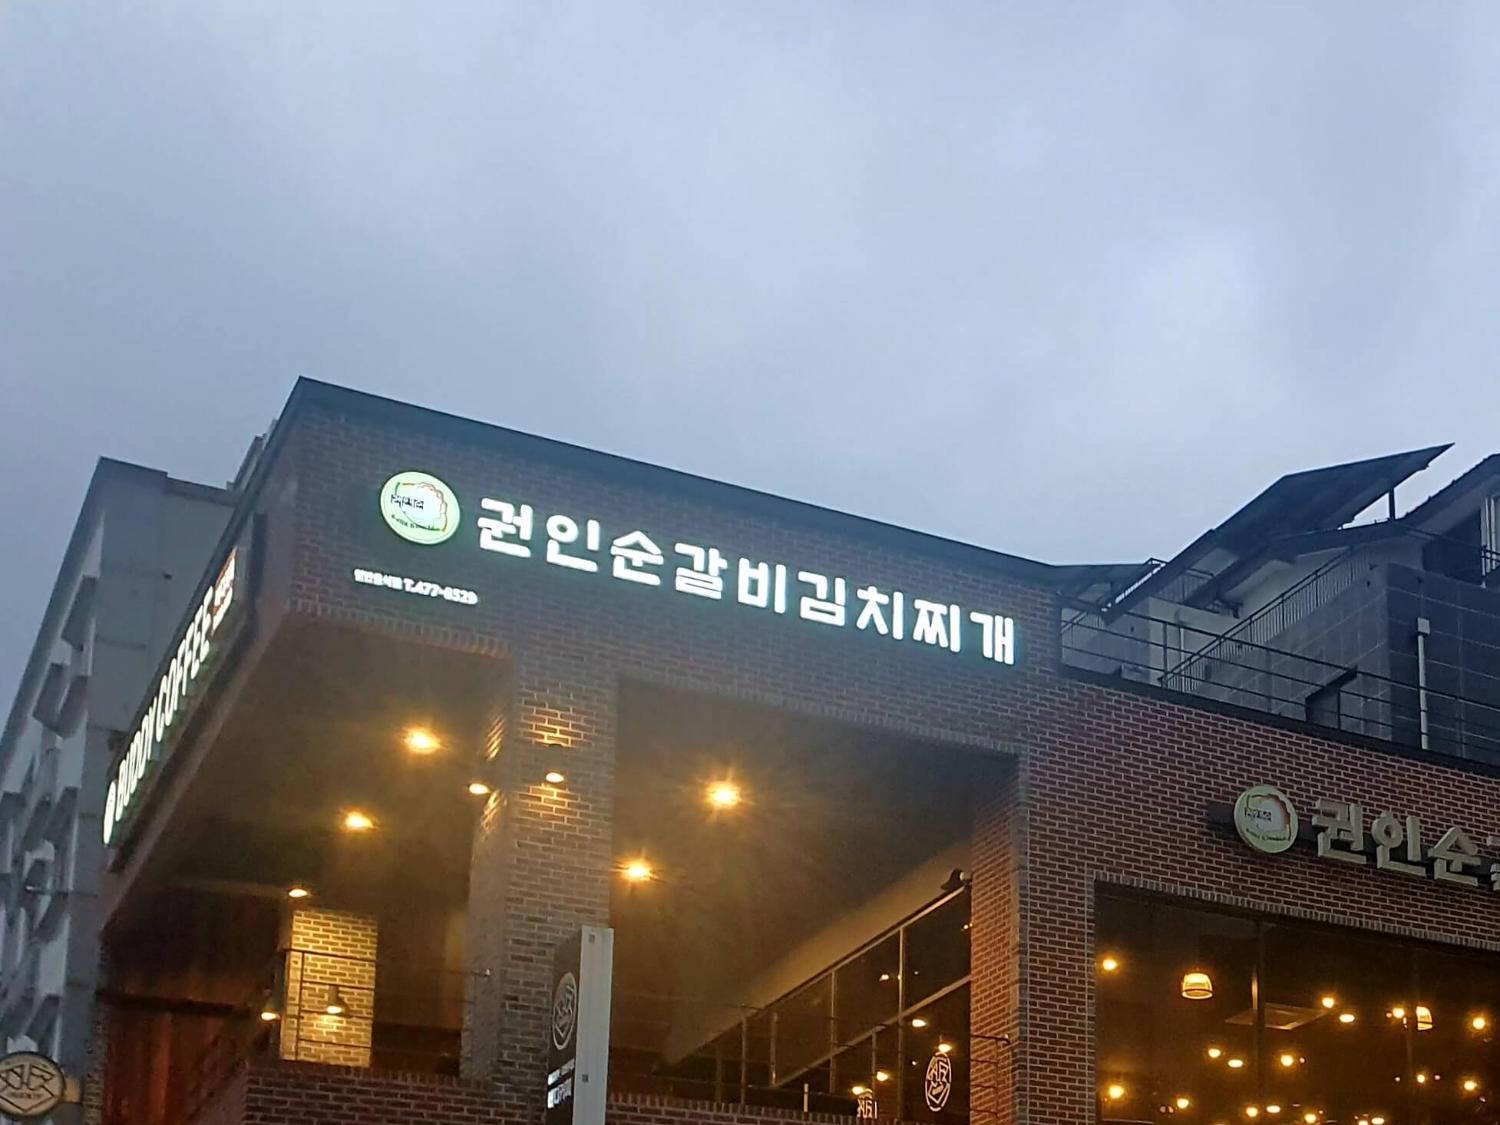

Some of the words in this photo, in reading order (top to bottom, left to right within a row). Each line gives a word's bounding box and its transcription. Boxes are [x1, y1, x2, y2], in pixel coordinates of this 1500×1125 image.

[476, 495, 1017, 665] 권인순갈비김치찌개
[115, 695, 158, 822] BUDDY
[155, 585, 214, 743] COFFEE
